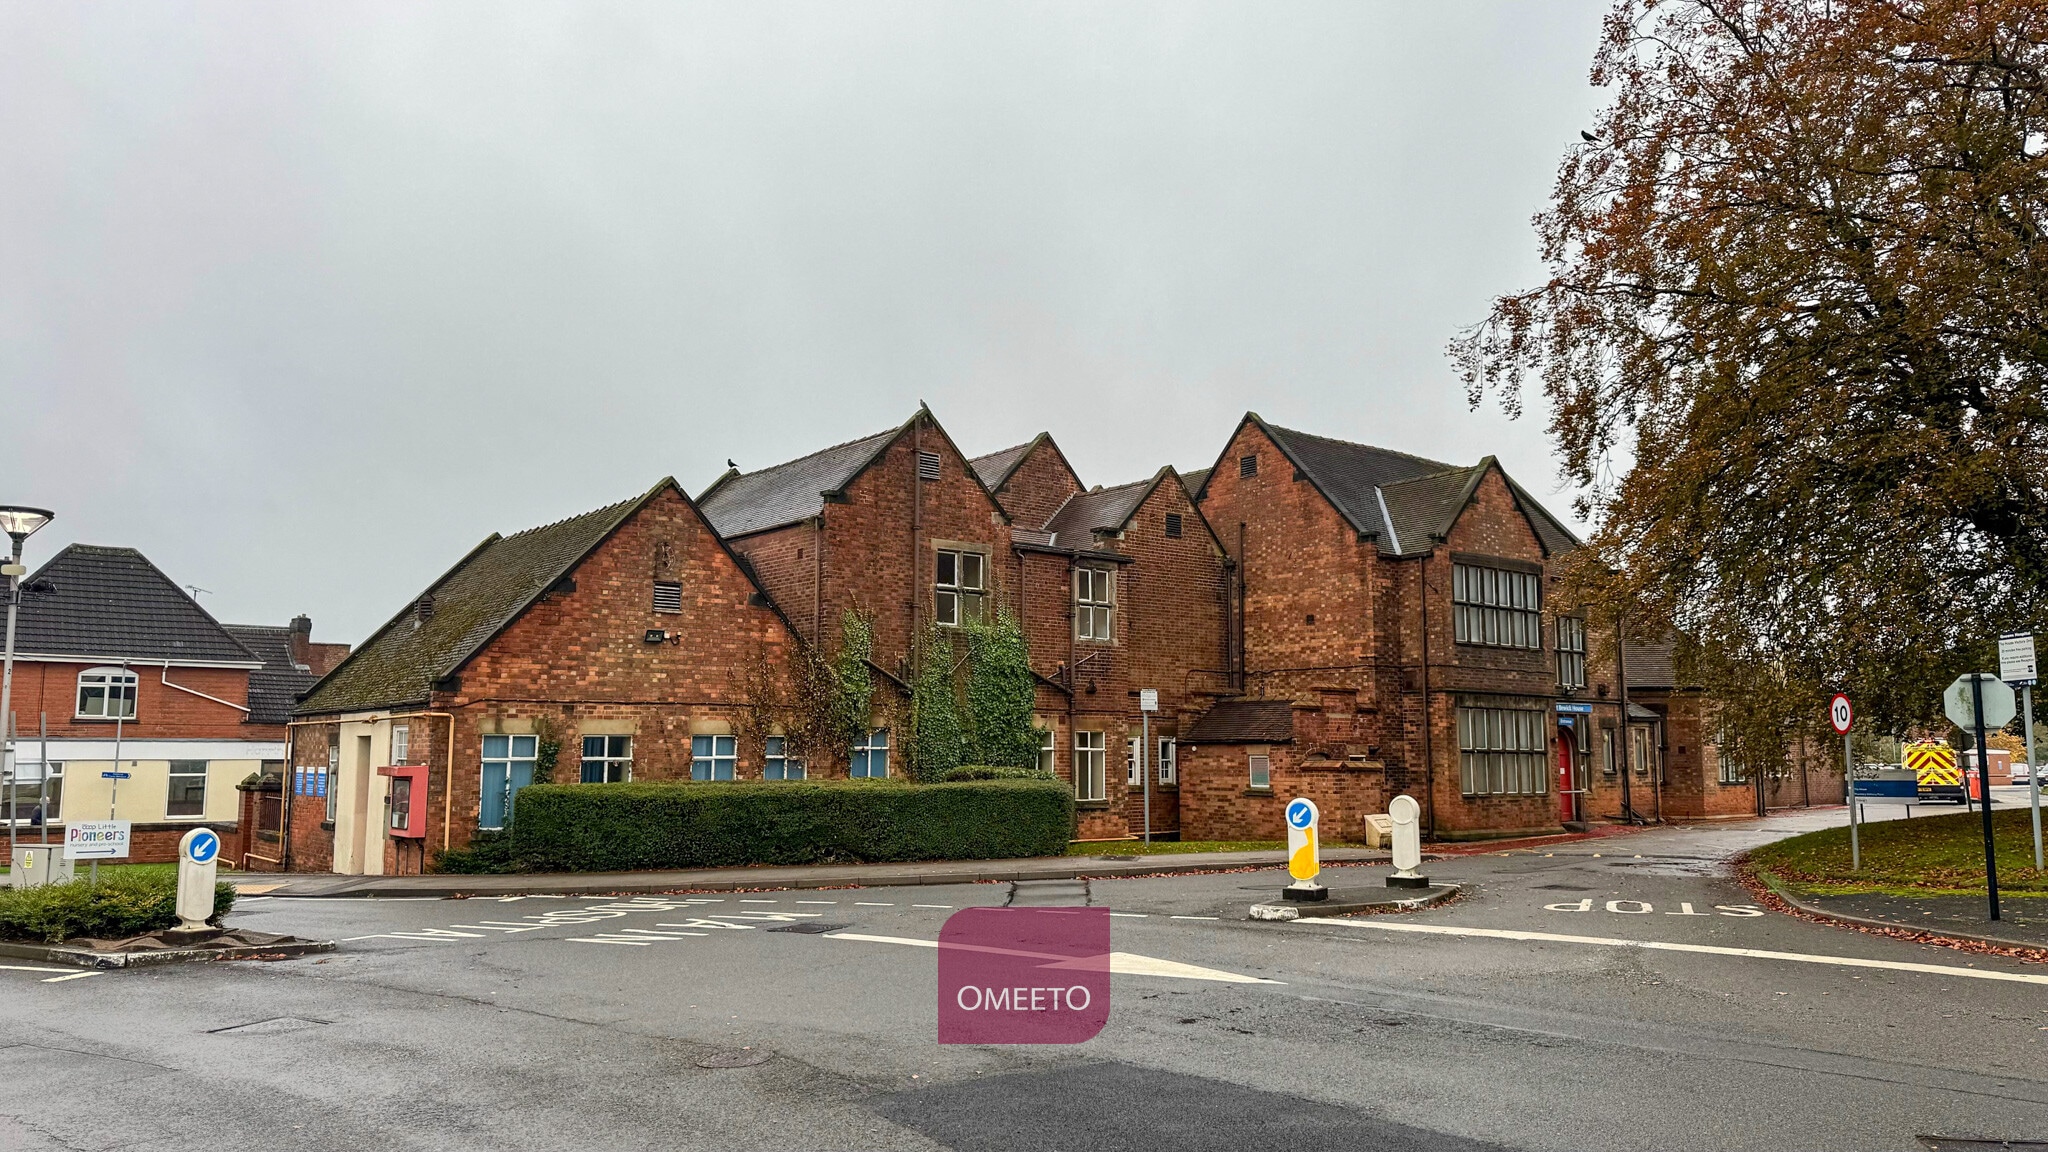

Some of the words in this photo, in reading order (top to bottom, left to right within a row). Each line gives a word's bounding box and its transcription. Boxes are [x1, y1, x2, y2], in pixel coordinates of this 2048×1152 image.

[1834, 705, 1848, 722] 10
[71, 828, 124, 841] Pioneers
[1542, 898, 1764, 917] STOP
[341, 900, 707, 941] HOSPITAL
[565, 910, 823, 946] MAIN
